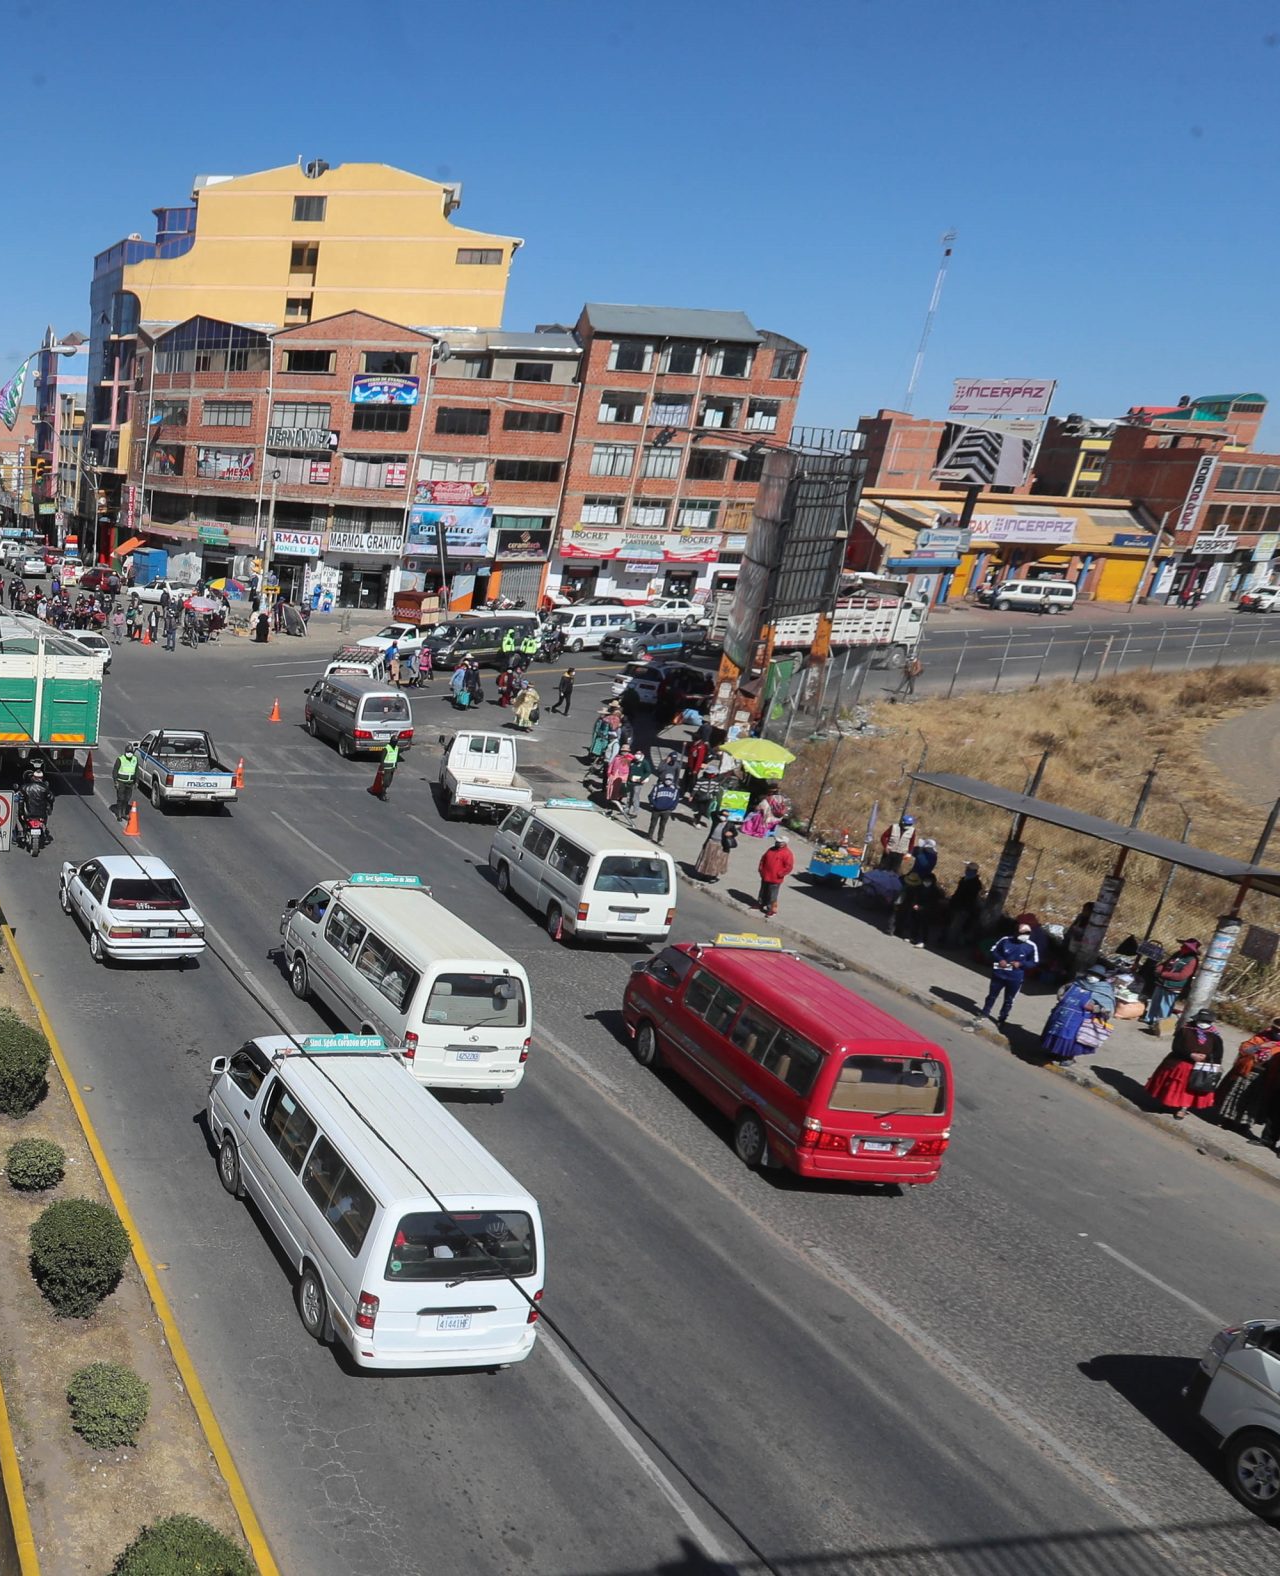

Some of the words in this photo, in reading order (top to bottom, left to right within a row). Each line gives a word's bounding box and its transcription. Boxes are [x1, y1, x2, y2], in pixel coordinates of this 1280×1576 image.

[966, 386, 1046, 398] INCERPAZ
[267, 428, 331, 449] HERNANDEZ
[226, 467, 250, 477] MESA
[1180, 457, 1214, 529] SOBOPRET
[1004, 518, 1074, 533] INCERPAZ
[273, 532, 320, 546] RMACIA
[571, 530, 609, 540] ISOCRET
[679, 535, 715, 545] ISOCRET
[330, 533, 364, 549] MARMOL
[366, 534, 402, 550] GRANITO
[1195, 539, 1238, 551] SOBOPRET
[360, 1038, 367, 1047] de
